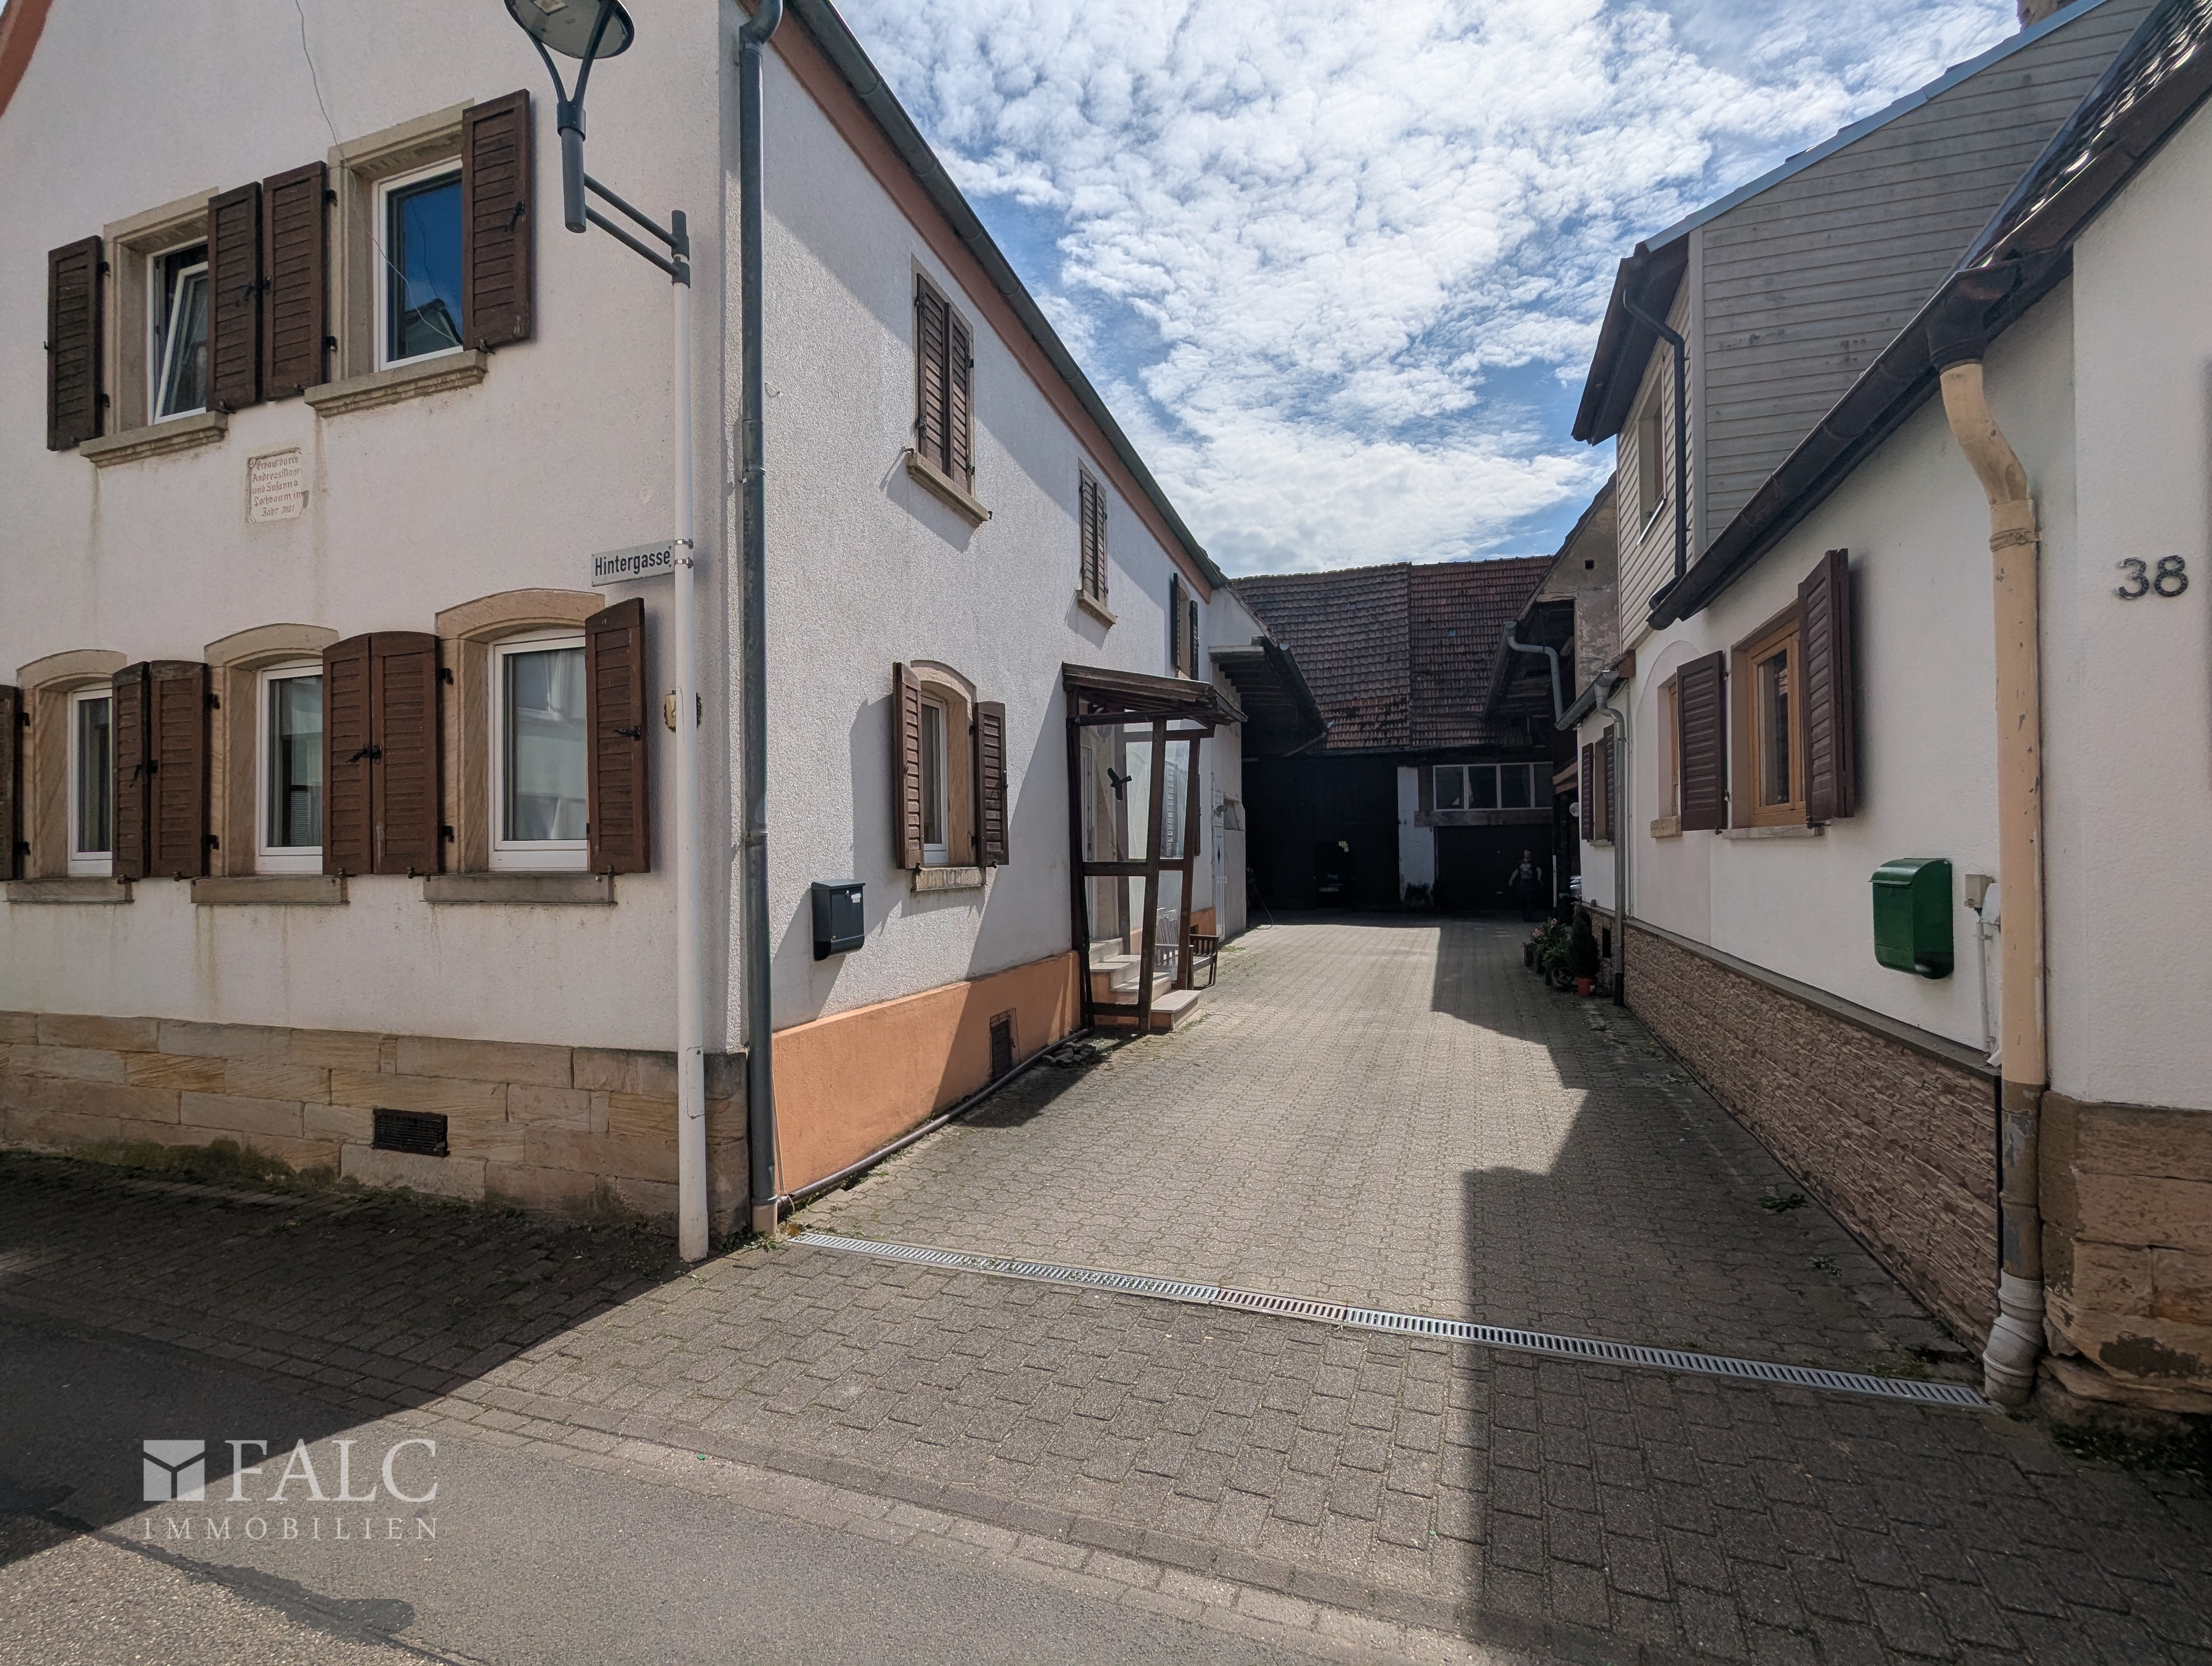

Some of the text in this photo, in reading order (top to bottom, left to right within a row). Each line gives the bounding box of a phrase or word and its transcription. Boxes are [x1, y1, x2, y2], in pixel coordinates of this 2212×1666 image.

[252, 472, 281, 483] Andreas
[252, 485, 265, 495] und
[261, 507, 279, 517] Jahr
[595, 550, 671, 576] Hintergasse
[2117, 554, 2189, 600] 38
